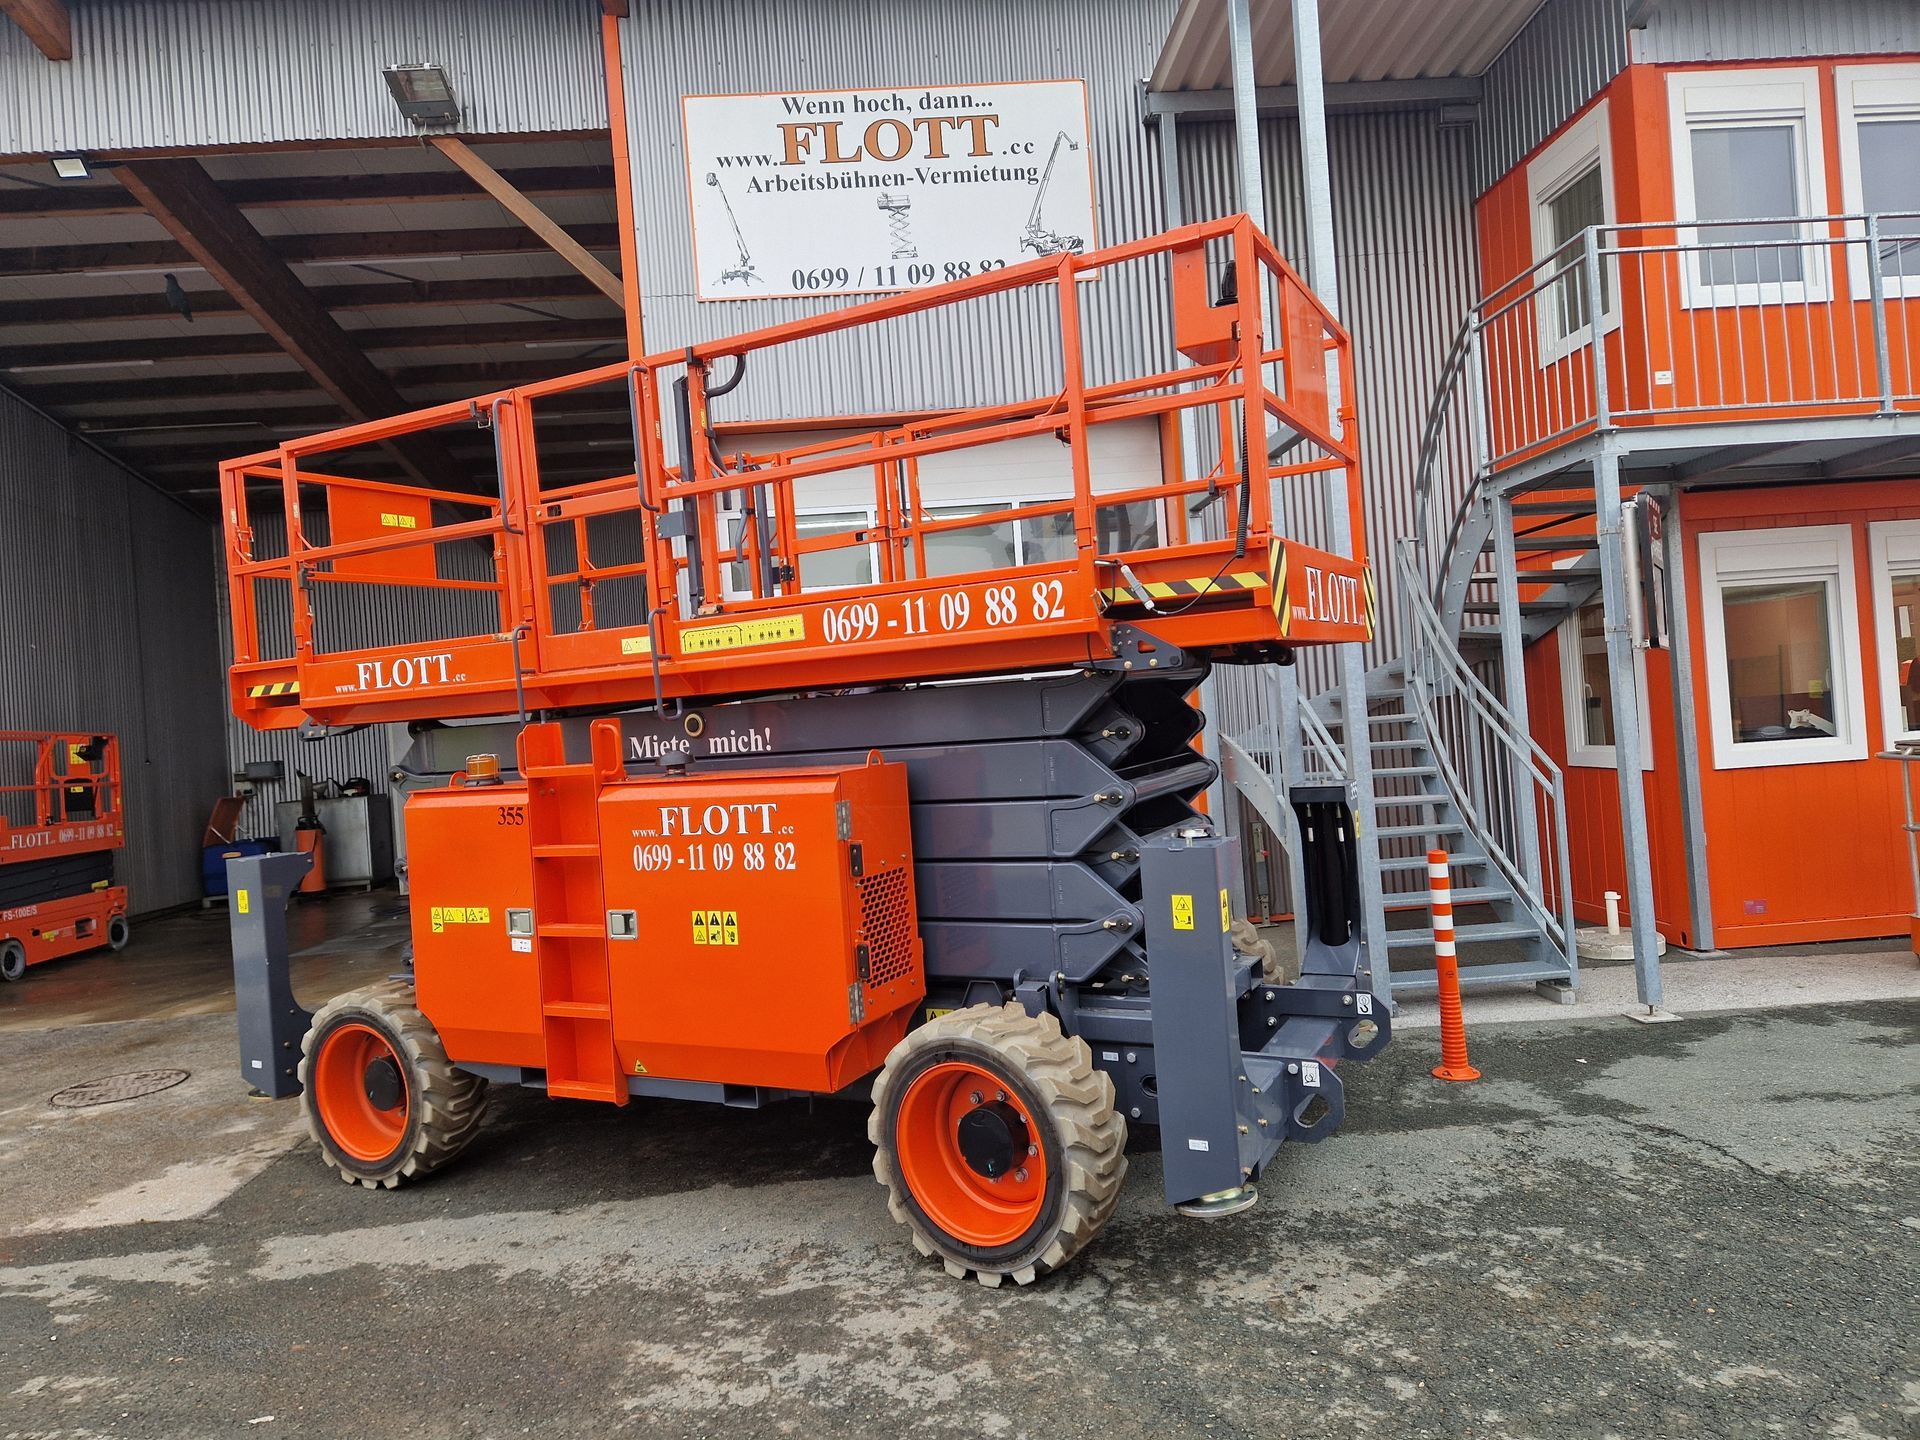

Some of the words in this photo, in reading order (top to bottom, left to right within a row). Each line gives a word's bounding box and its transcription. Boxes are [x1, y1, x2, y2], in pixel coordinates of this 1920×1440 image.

[782, 96, 845, 115] Wenn
[853, 93, 912, 114] hoch,
[919, 91, 993, 110] dann...
[746, 164, 1040, 194] Arbeitsbühnen-Vermietung
[792, 267, 849, 291] 0699
[857, 266, 865, 287] /
[874, 265, 897, 287] 11
[907, 263, 935, 285] 09
[943, 261, 972, 283] 88
[822, 602, 879, 644] 0699
[939, 591, 970, 631] 09
[984, 585, 1018, 626] 88
[1031, 579, 1066, 621] 82
[629, 735, 690, 759] Miete
[708, 727, 772, 754] mich!
[498, 806, 524, 826] 355
[633, 843, 672, 872] 0699
[713, 842, 734, 870] 09
[743, 842, 765, 870] 88
[774, 842, 797, 870] 82
